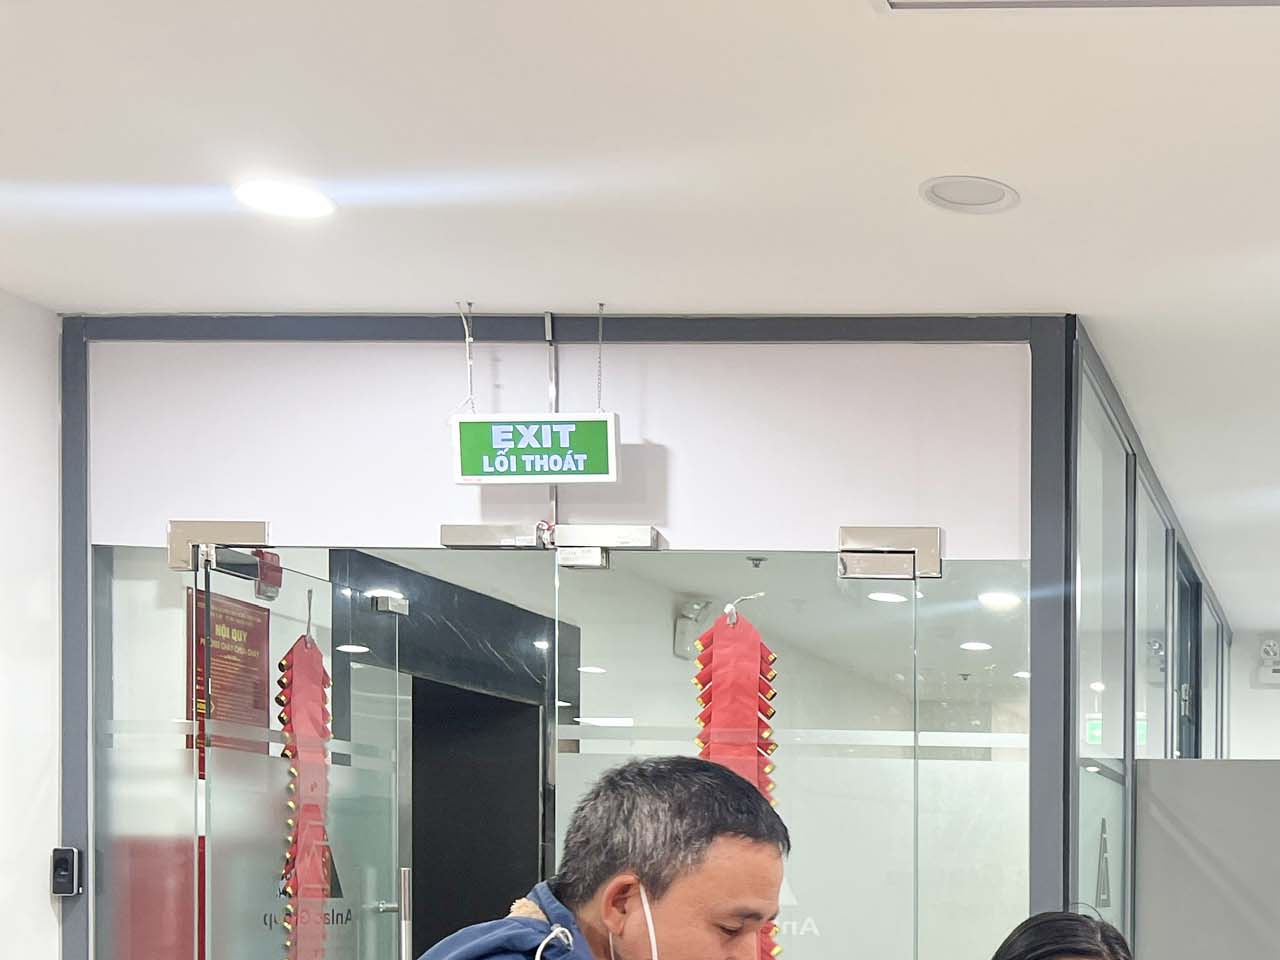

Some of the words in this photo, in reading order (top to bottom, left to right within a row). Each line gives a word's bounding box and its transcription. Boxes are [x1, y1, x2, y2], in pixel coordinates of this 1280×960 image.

[491, 424, 576, 449] EXIT
[482, 448, 517, 473] LỐI
[521, 450, 588, 472] THOÁT
